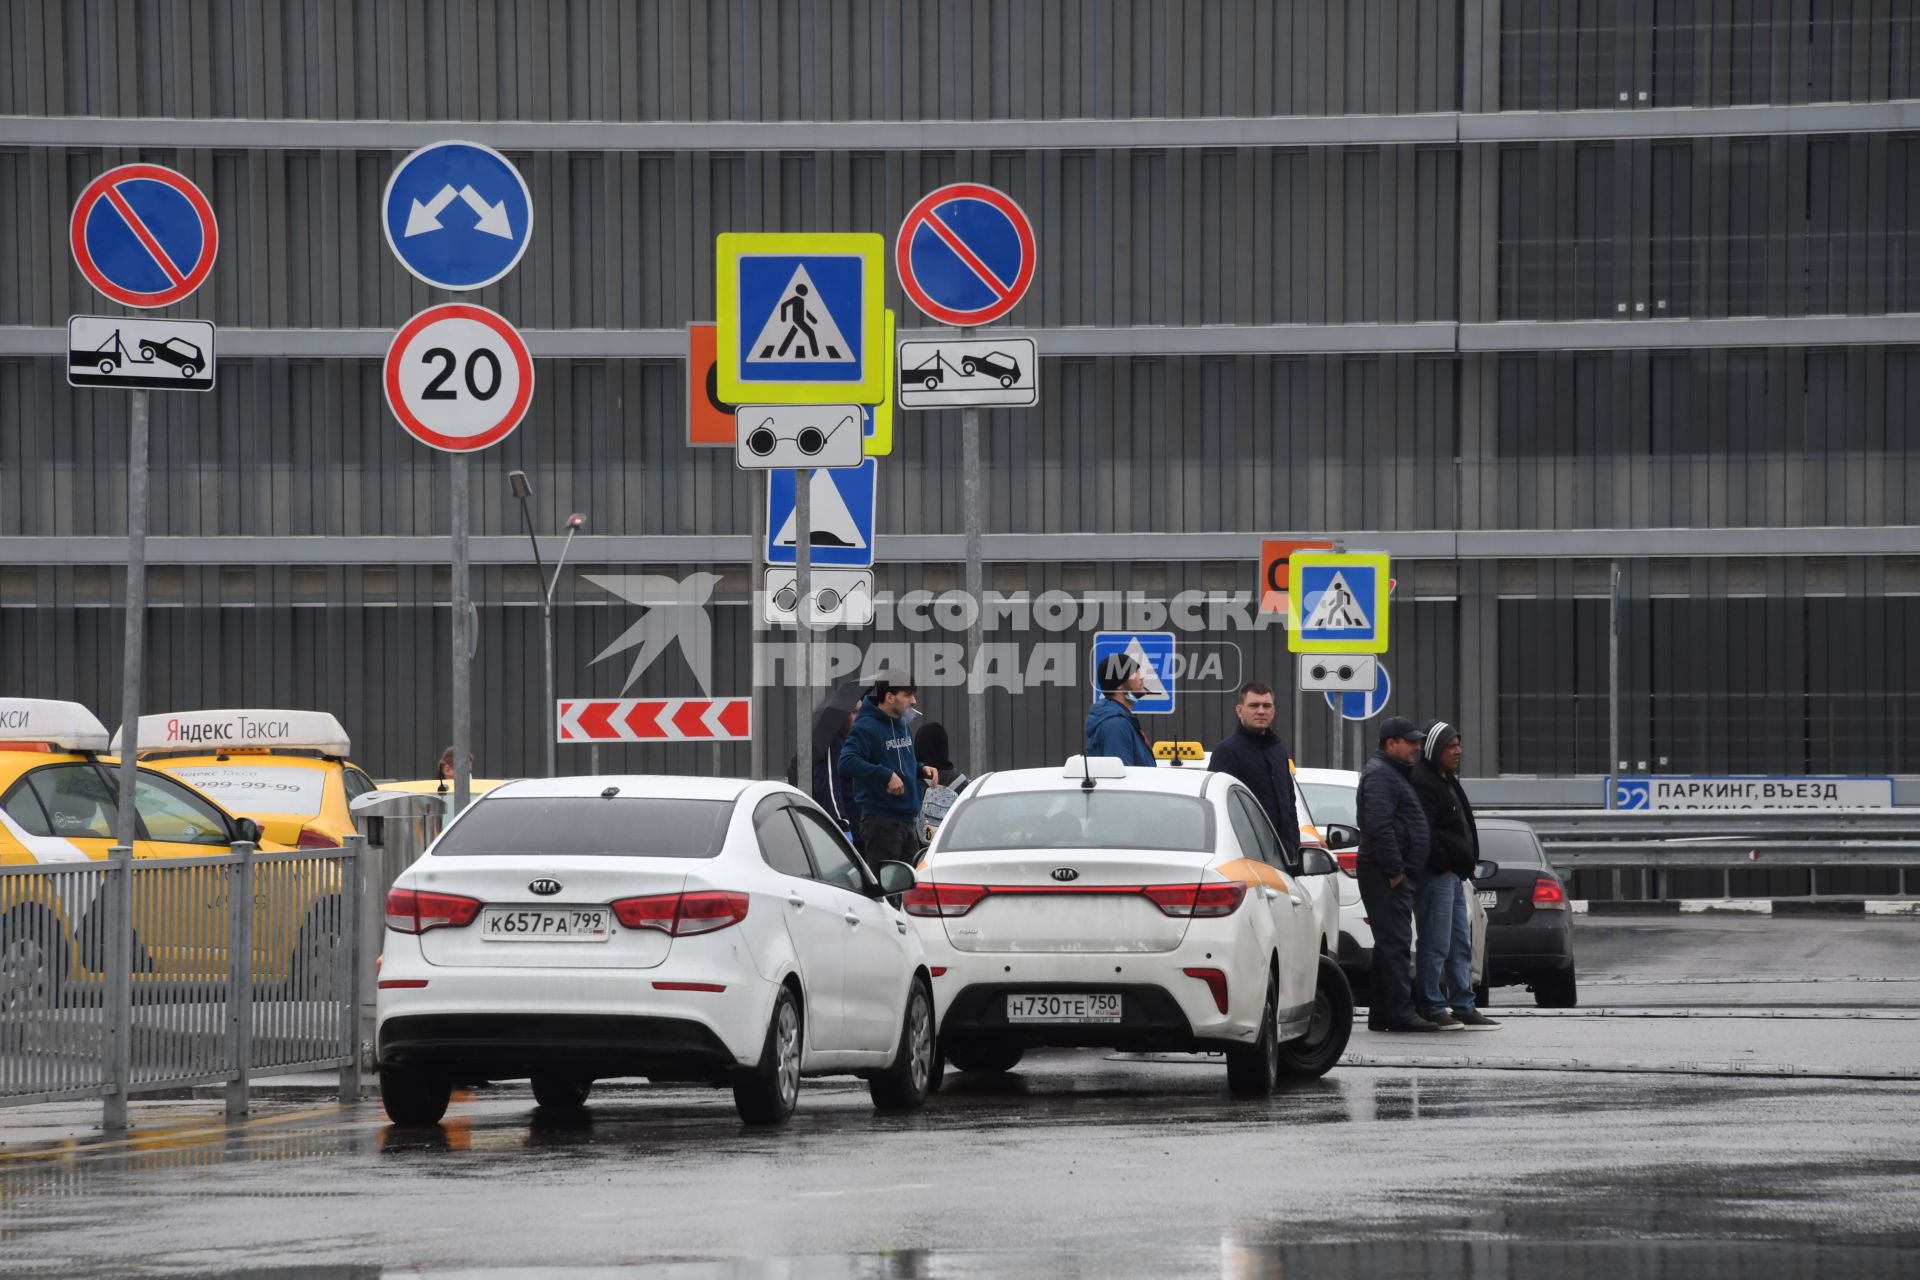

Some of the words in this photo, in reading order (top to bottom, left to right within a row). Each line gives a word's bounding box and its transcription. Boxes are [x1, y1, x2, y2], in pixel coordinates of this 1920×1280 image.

[421, 347, 502, 401] 20
[167, 719, 233, 743] Яндекс
[238, 716, 289, 739] Такси
[1658, 784, 1758, 801] ПАРКИНГ,
[1763, 784, 1838, 799] ВЪЕЗД
[1054, 869, 1074, 879] KIA
[532, 880, 557, 892] KIA
[491, 912, 568, 932] К657РА
[573, 913, 601, 927] 799
[1013, 997, 1085, 1015] Н730ТЕ
[1089, 996, 1117, 1010] 750
